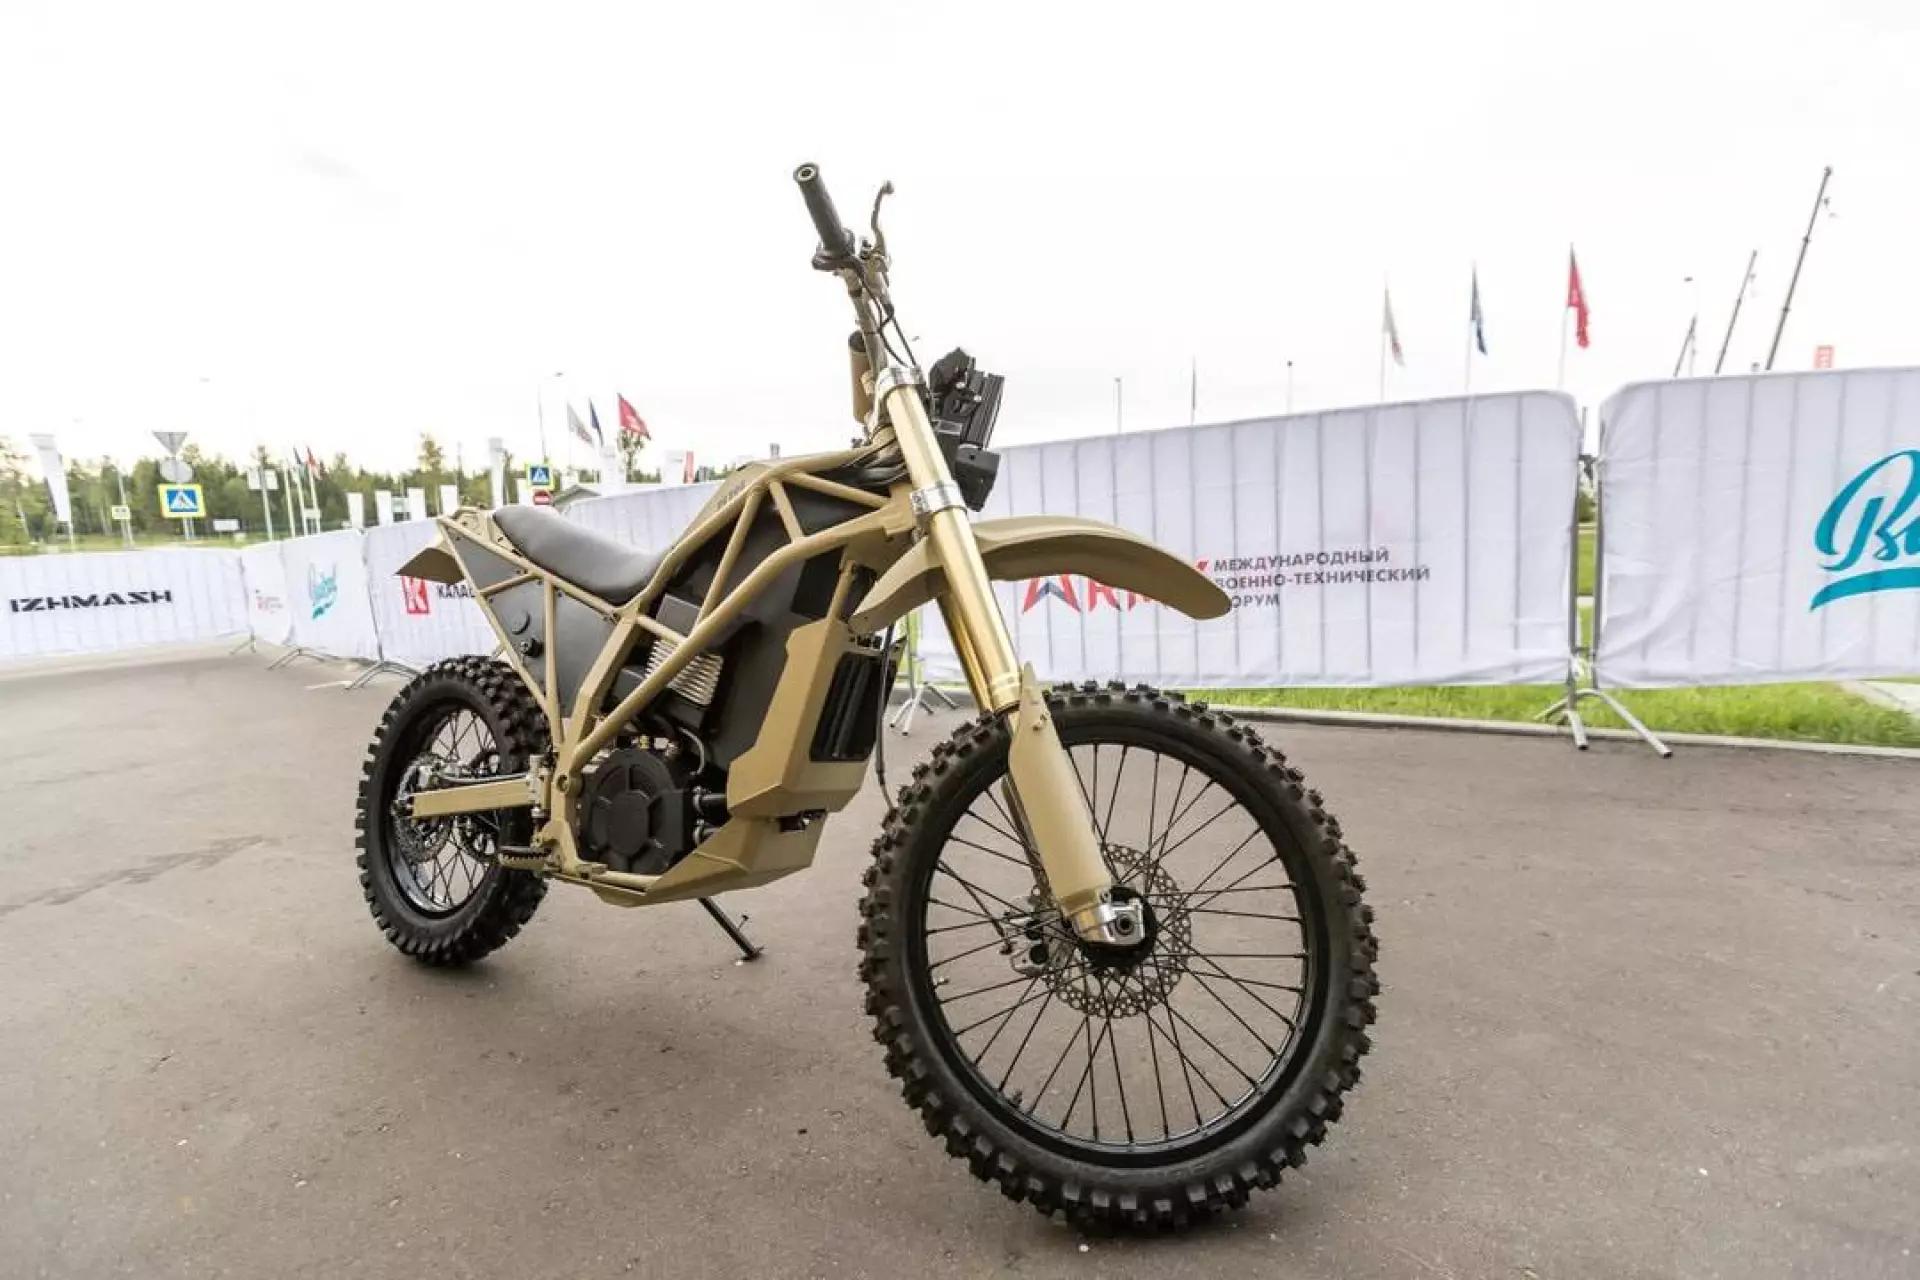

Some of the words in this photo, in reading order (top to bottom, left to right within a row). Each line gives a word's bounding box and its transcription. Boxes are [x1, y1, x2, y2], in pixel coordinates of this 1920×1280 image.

[1213, 547, 1389, 572] МЕЖДУНАРОДНЫЙ
[10, 590, 172, 612] IZHMASH
[1231, 593, 1280, 609] ОРУМ
